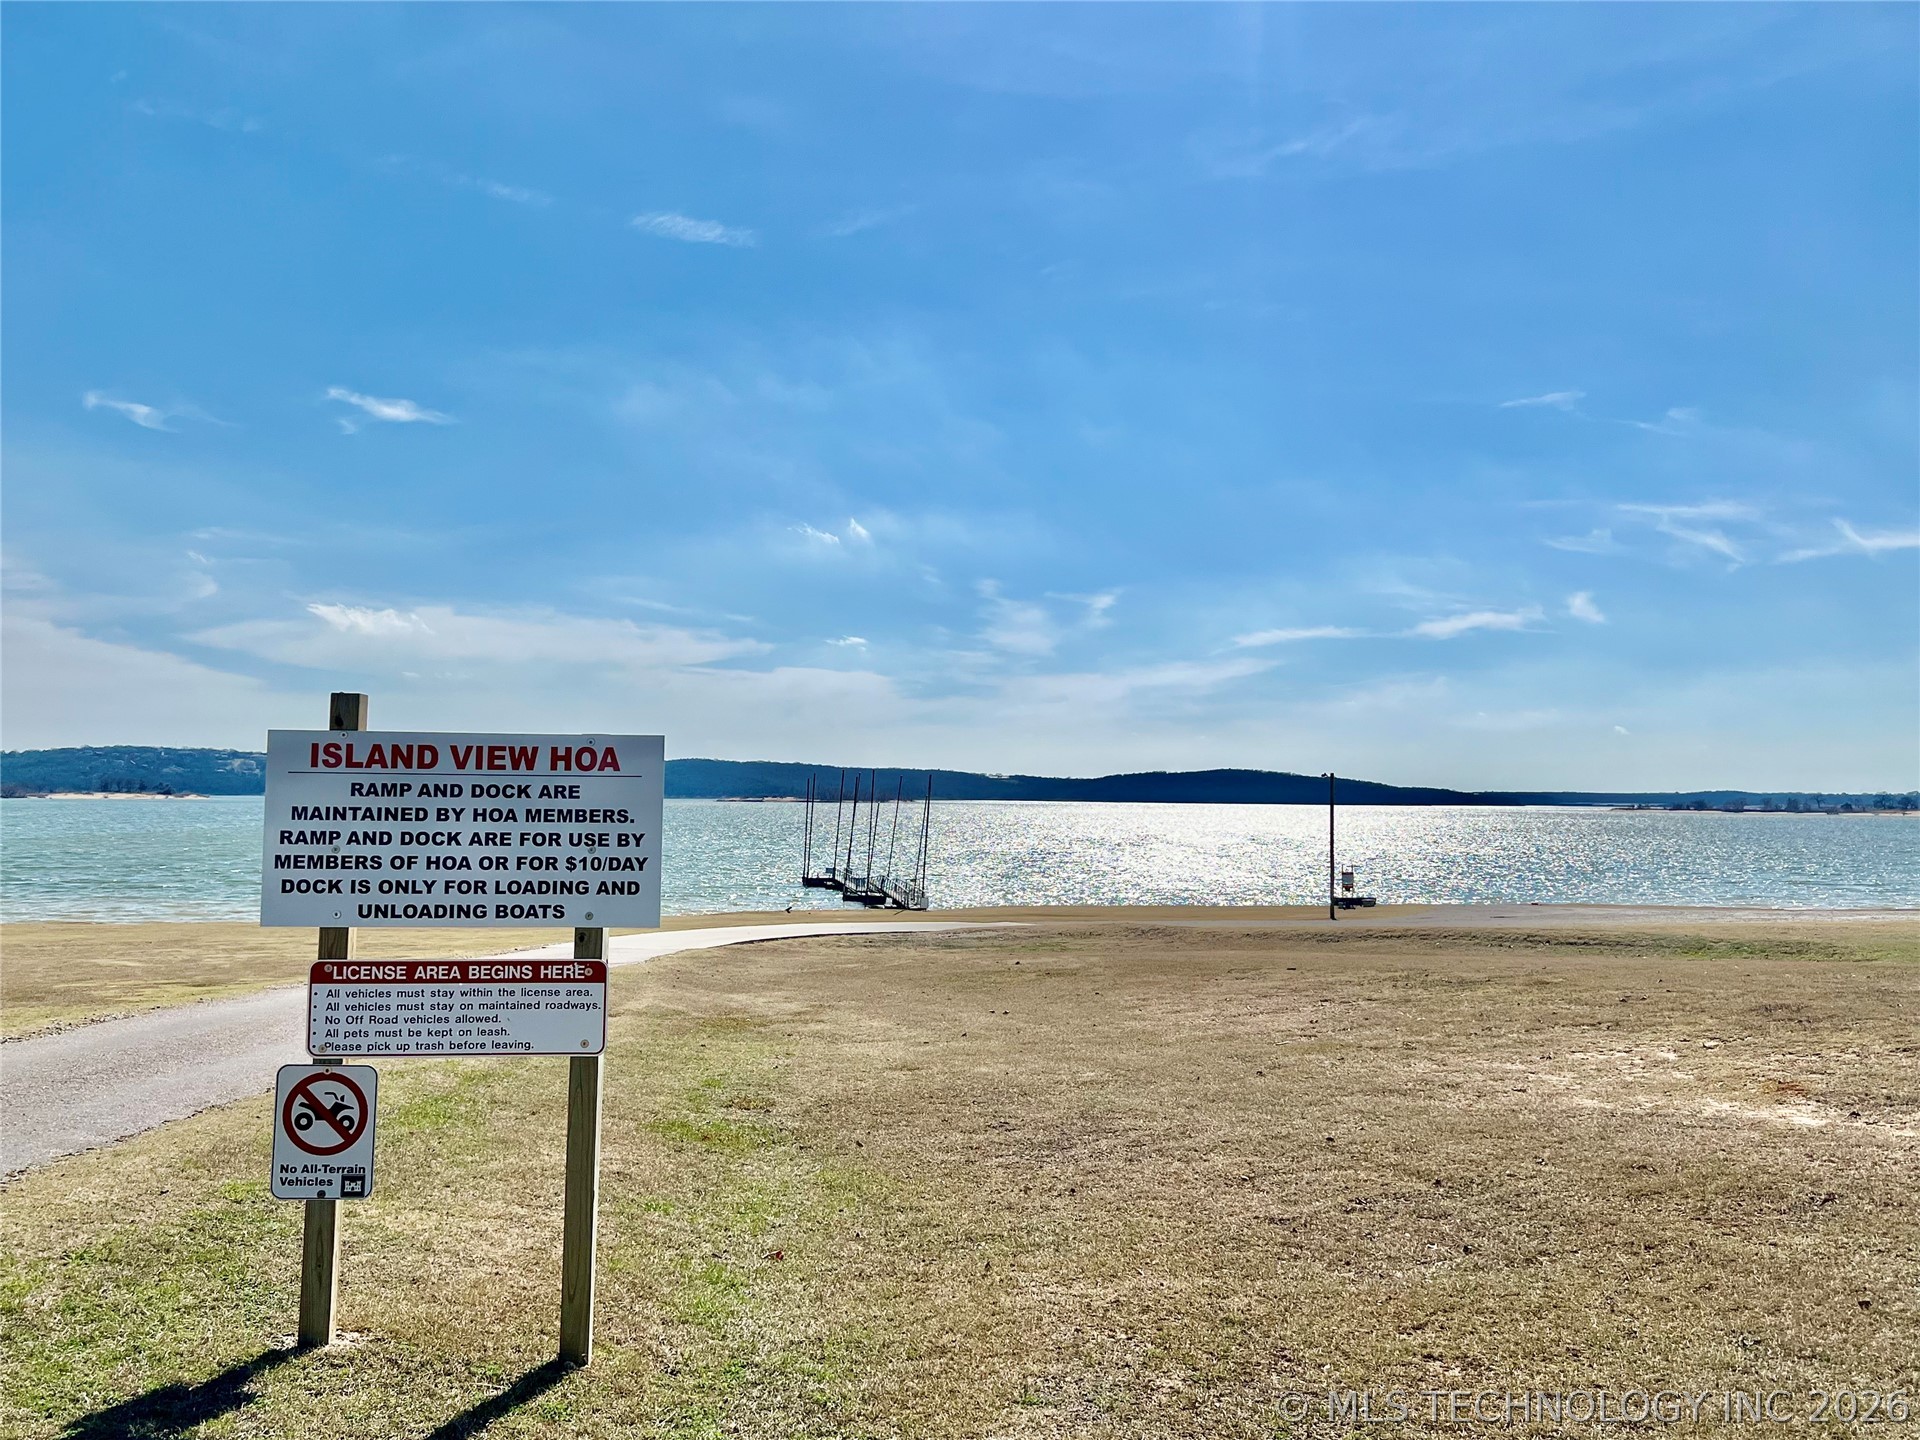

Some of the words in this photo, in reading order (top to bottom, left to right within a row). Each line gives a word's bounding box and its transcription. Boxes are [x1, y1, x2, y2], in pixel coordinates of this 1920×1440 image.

[309, 742, 439, 770] ISLAND
[450, 745, 538, 771] VIEW
[550, 746, 620, 772] HOA
[350, 782, 412, 797] RAMP
[418, 783, 464, 798] AND
[471, 784, 531, 799] DOCK
[538, 784, 580, 799] ARE
[290, 806, 429, 822] MAINTAINED
[436, 808, 465, 822] BY
[473, 808, 518, 823] HOA
[525, 809, 635, 824] MEMBERS.
[279, 830, 342, 845] RAMP
[347, 831, 392, 846] AND
[400, 831, 462, 847] DOCK
[468, 832, 512, 847] ARE
[519, 832, 562, 847] FOR
[569, 833, 610, 848] USE
[617, 833, 645, 848] BY
[274, 855, 382, 870] MEMBERS
[390, 855, 418, 871] OF
[425, 856, 471, 871] HOA
[478, 856, 510, 871] OR
[516, 856, 558, 871] FOR
[565, 856, 648, 872] $10/DAY
[281, 879, 343, 894] DOCK
[350, 879, 370, 894] IS
[378, 879, 437, 895] ONLY
[444, 880, 488, 895] FOR
[495, 880, 590, 895] LOADING
[596, 880, 640, 895] AND
[357, 904, 488, 919] UNLOADING
[495, 904, 565, 919] BOATS
[333, 966, 406, 980] LICENSE
[414, 966, 461, 980] AREA
[468, 966, 532, 979] BEGINS
[540, 965, 585, 979] HERE
[326, 988, 340, 998] All
[344, 988, 392, 998] vehicles
[396, 988, 425, 998] must
[430, 988, 454, 999] stay
[460, 988, 493, 997] within
[498, 988, 516, 997] the
[520, 987, 560, 997] license
[565, 989, 593, 997] area.
[326, 1002, 340, 1011] All
[344, 1002, 391, 1011] vehicles
[396, 1002, 425, 1011] must
[430, 1002, 454, 1013] stay
[459, 1002, 474, 1010] on
[478, 1000, 540, 1010] maintained
[545, 1000, 601, 1011] roadways.
[324, 1016, 340, 1025] No
[346, 1015, 364, 1024] Off
[369, 1015, 398, 1024] Road
[404, 1014, 450, 1024] vehicles
[455, 1014, 501, 1024] allowed.
[325, 1028, 339, 1038] All
[344, 1029, 369, 1039] pets
[374, 1029, 402, 1038] must
[408, 1028, 422, 1037] be
[427, 1028, 452, 1038] kept
[458, 1029, 472, 1037] on
[477, 1027, 510, 1036] leash.
[324, 1042, 362, 1051] Please
[367, 1041, 392, 1052] pick
[396, 1042, 410, 1052] up
[415, 1040, 445, 1050] trash
[449, 1040, 487, 1050] before
[492, 1040, 534, 1051] leaving.
[280, 1164, 297, 1174] No
[301, 1164, 366, 1174] All-Terrain
[280, 1177, 333, 1186] Vehicles
